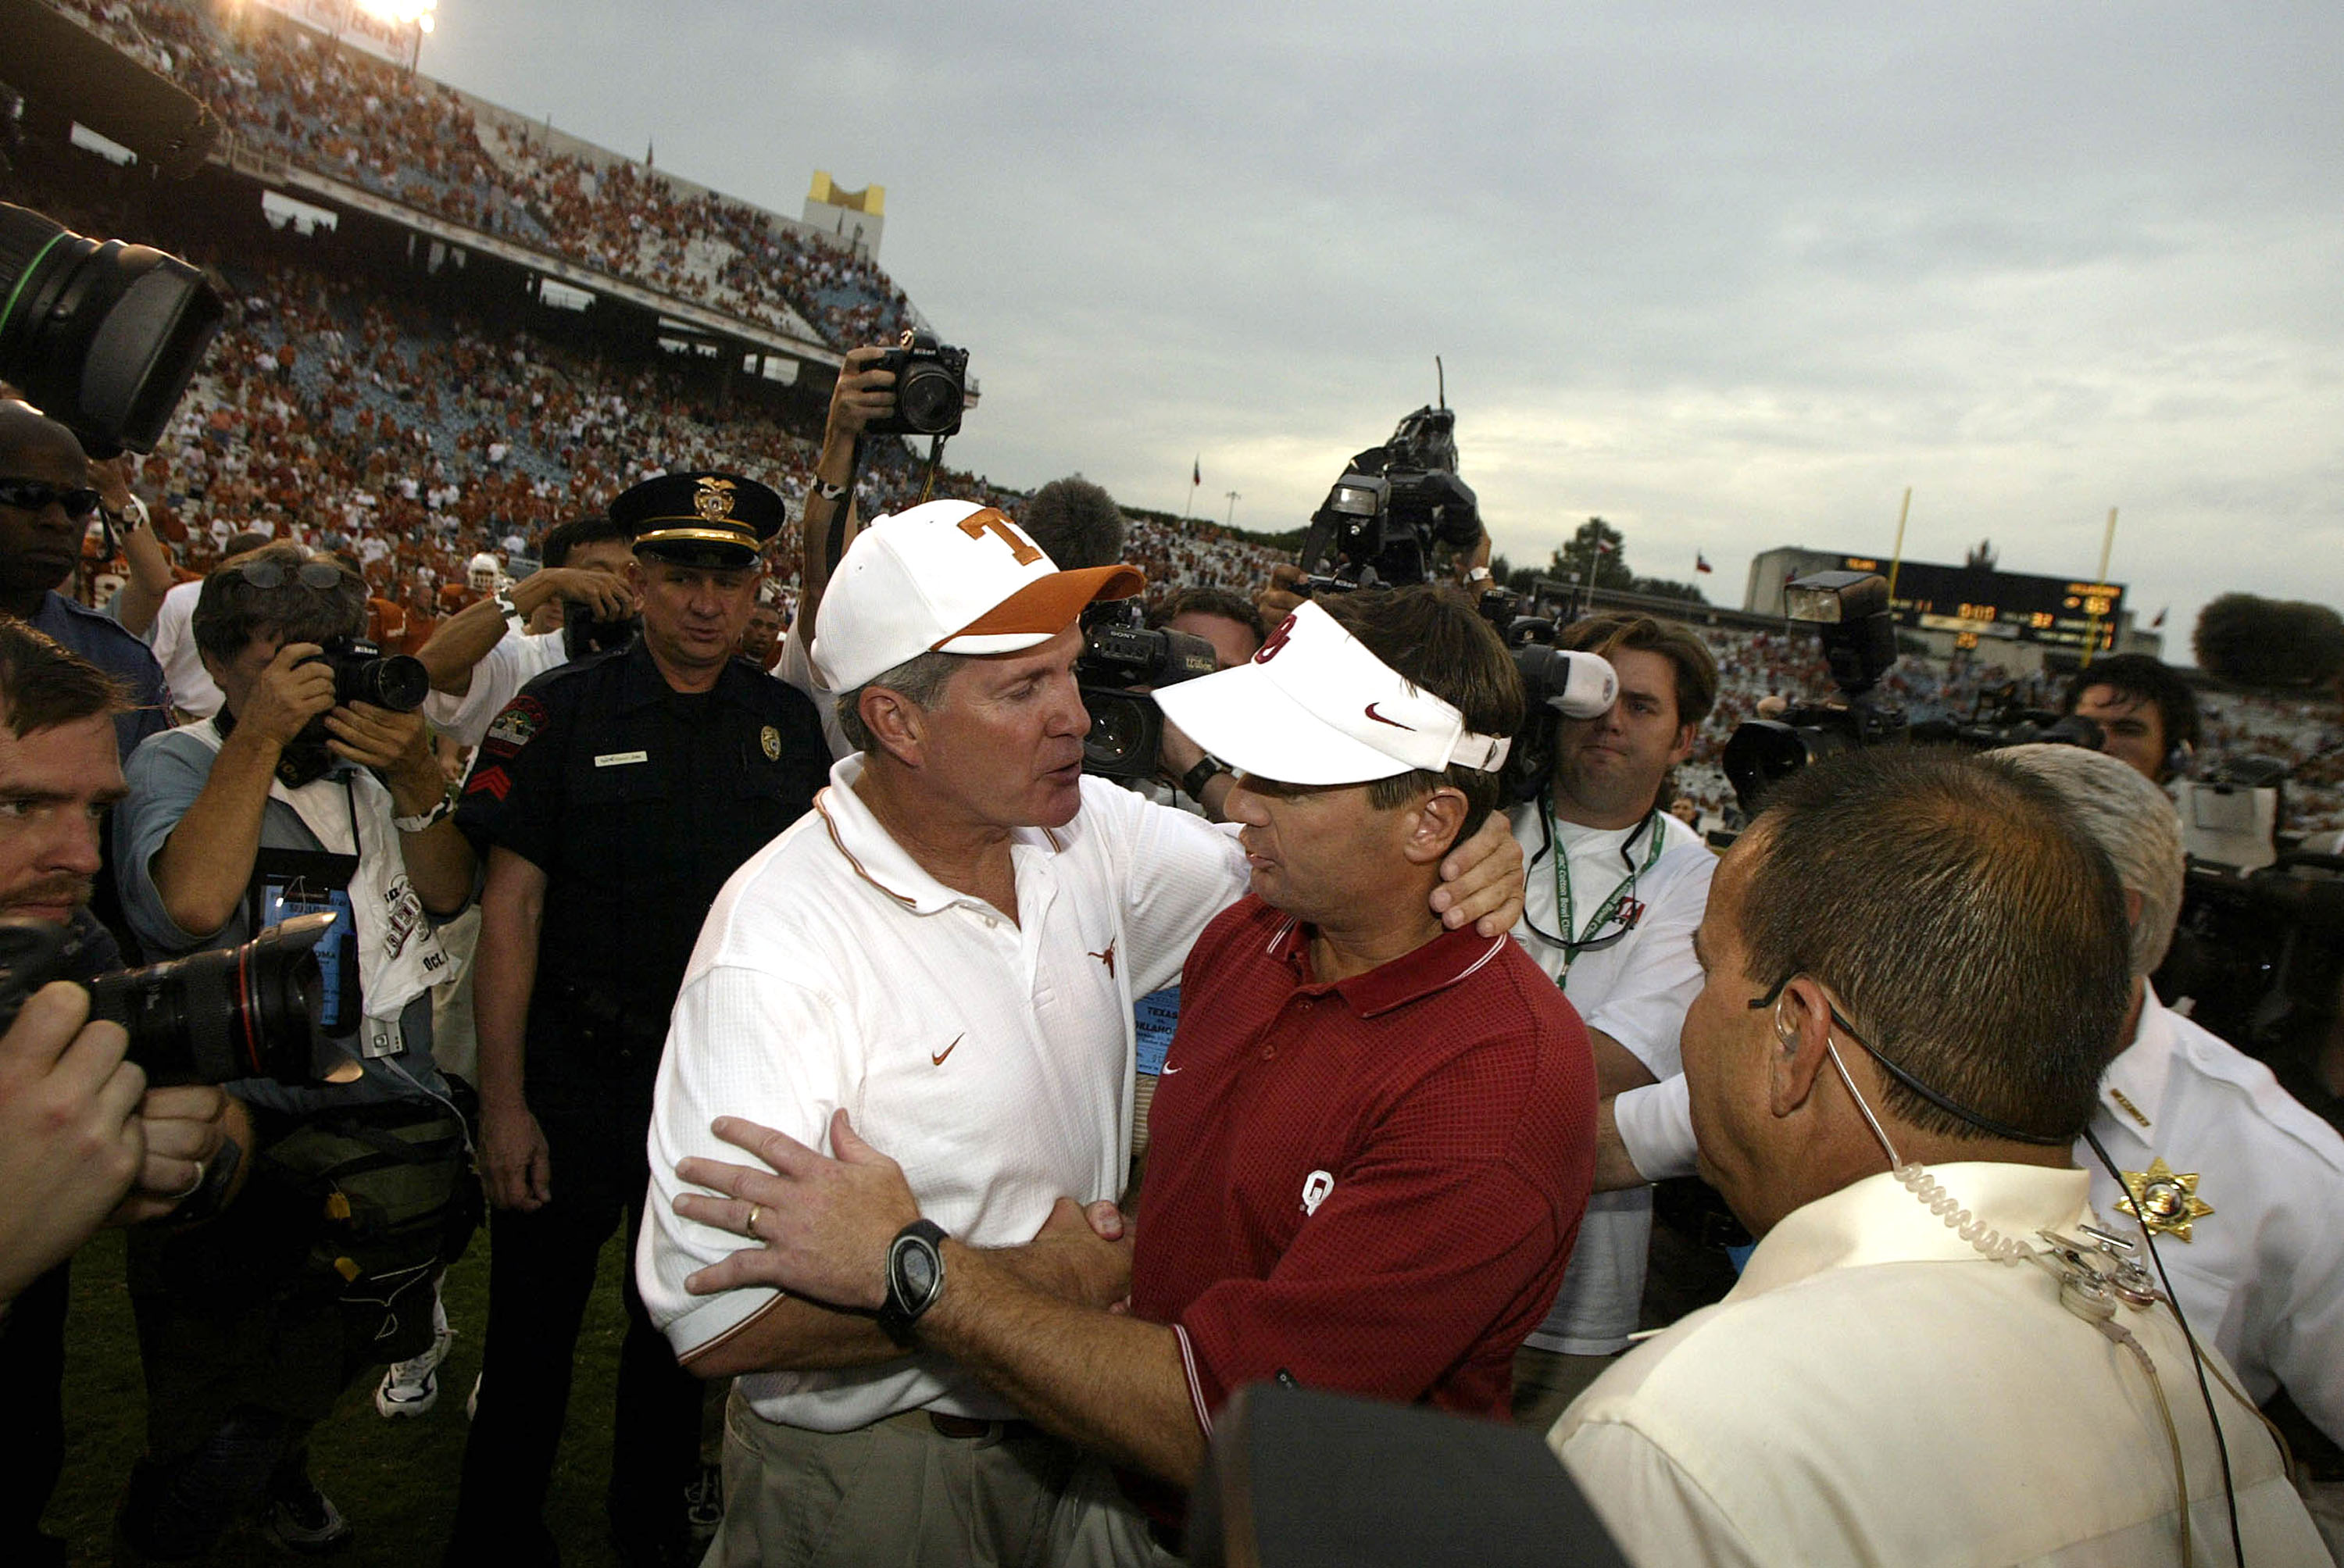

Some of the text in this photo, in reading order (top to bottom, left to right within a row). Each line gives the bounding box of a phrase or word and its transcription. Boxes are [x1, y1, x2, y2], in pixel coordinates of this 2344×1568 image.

[956, 506, 1043, 566] T
[1109, 630, 1137, 640] SONY
[1560, 898, 1570, 919] Bowl
